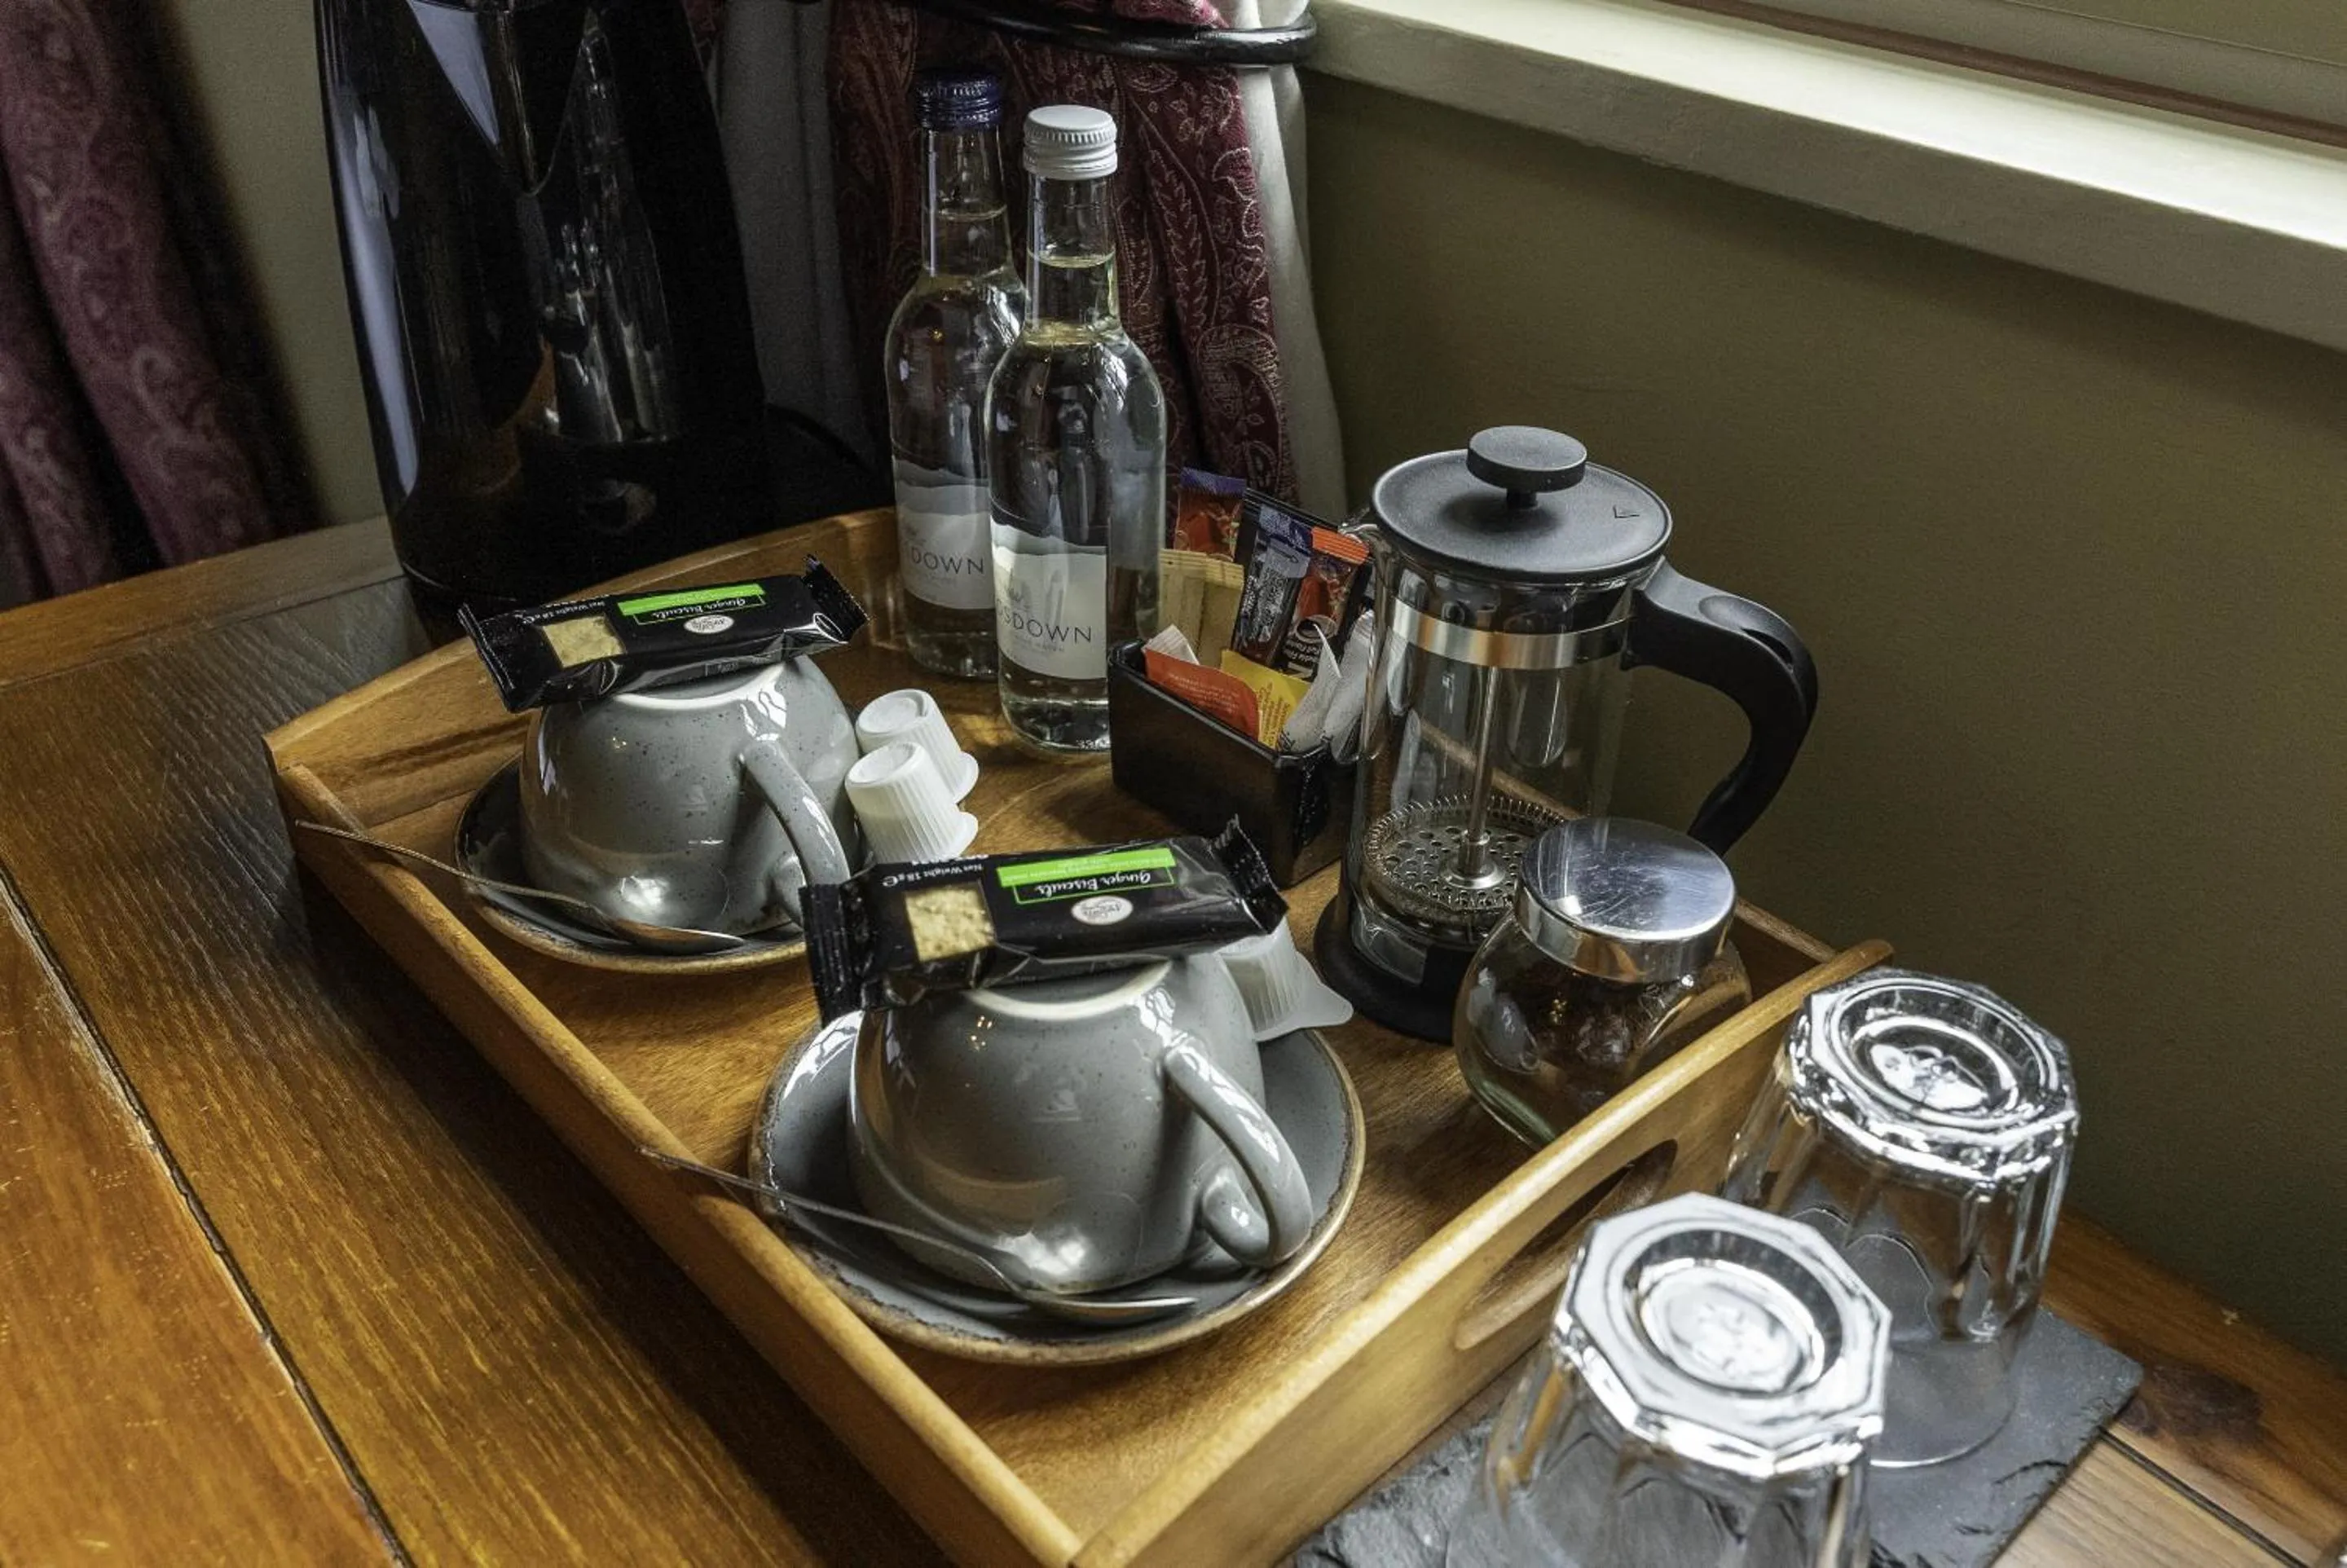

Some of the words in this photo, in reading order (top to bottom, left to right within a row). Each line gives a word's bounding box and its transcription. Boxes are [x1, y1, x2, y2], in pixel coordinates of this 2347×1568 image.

[923, 866, 963, 878] Weight
[1100, 870, 1151, 886] Ginger
[1034, 879, 1099, 897] Biscuits
